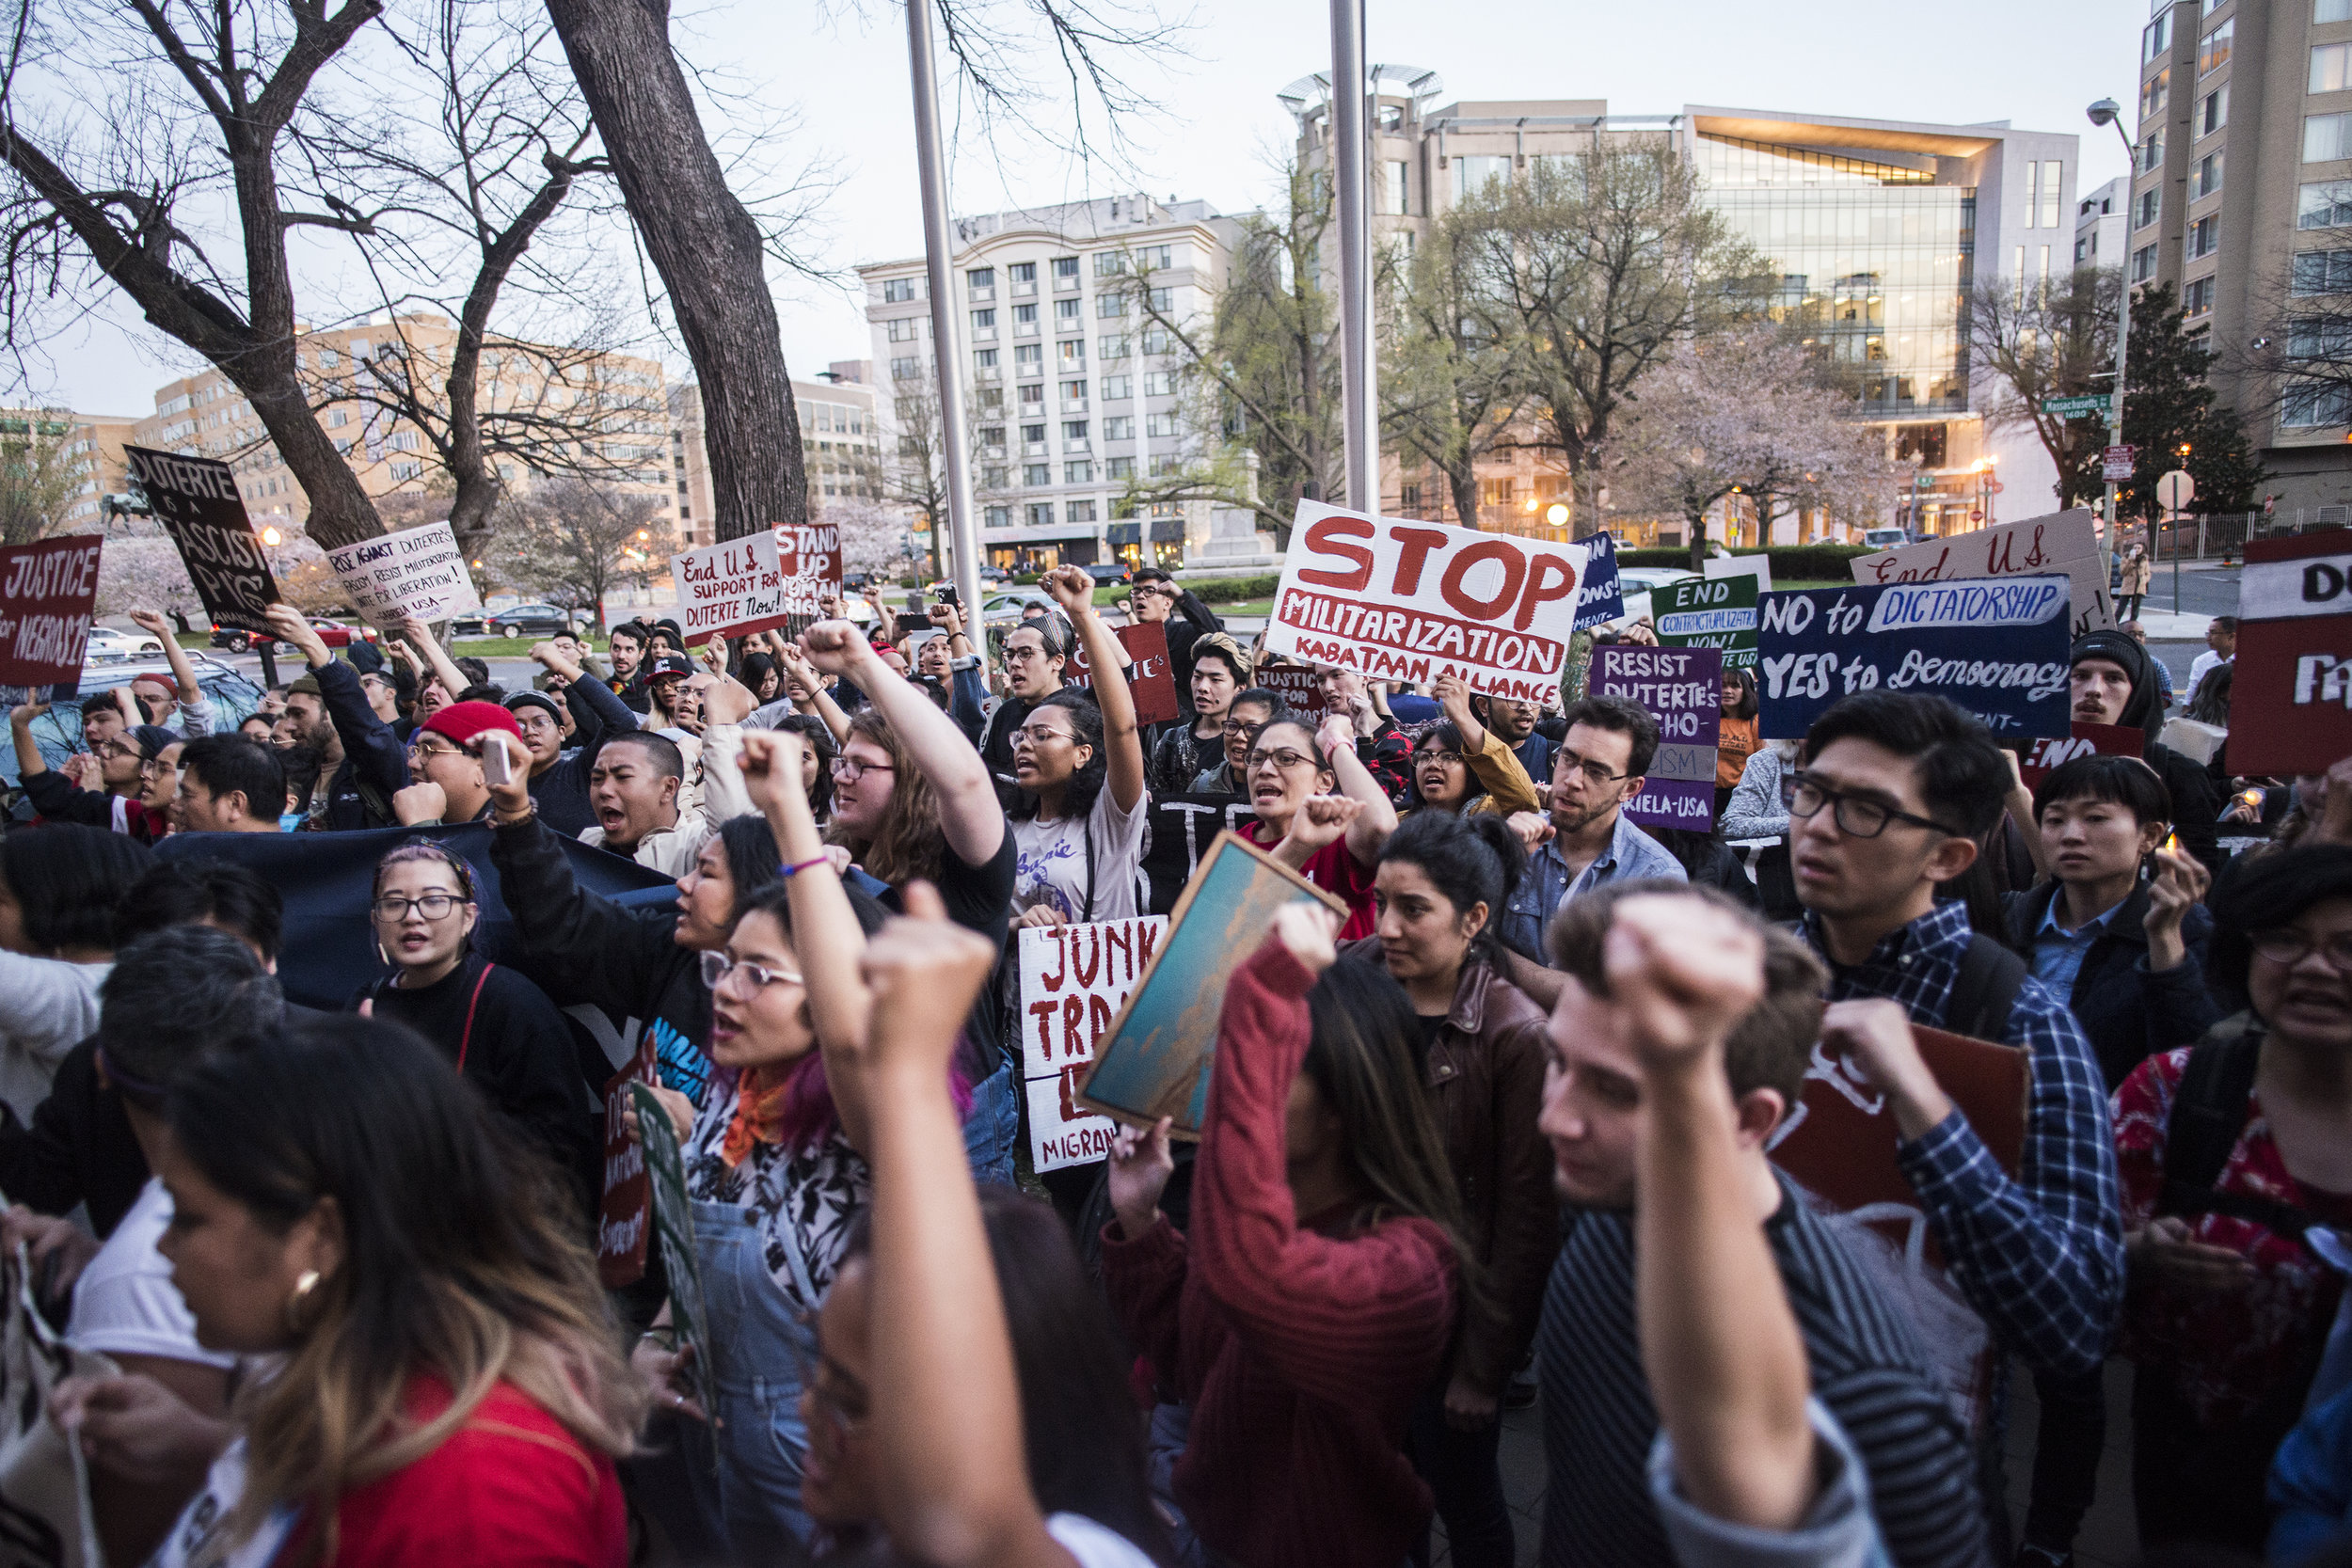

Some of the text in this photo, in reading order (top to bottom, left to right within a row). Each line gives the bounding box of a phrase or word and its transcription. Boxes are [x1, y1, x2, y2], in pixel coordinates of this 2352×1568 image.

[2045, 398, 2098, 411] Massachusetts
[2065, 410, 2087, 419] 1600
[127, 450, 239, 501] DUTERTE
[163, 494, 201, 515] IS A
[157, 513, 266, 572] FASCIST
[773, 525, 840, 555] STAND
[1986, 524, 2051, 575] U.S.
[5, 546, 100, 601] JUSTICE
[329, 551, 357, 575] RISE
[356, 542, 394, 566] AGAINST
[373, 566, 403, 584] RESIST
[680, 544, 763, 583] End U.S.
[796, 553, 830, 577] UP
[1297, 515, 1576, 632] STOP
[192, 562, 269, 619] PIG
[375, 590, 390, 606] FOR
[693, 570, 780, 599] SUPPORT FOR
[1676, 581, 1730, 607] END
[687, 600, 739, 627] DUTERTE
[1761, 584, 2058, 636] NO to DICTATORSHIP
[1284, 592, 1556, 673] MILITARIZATION
[1295, 636, 1430, 684] KABATAAN
[1604, 651, 1692, 679] RESIST
[1761, 649, 2070, 703] YES to Democracy
[1258, 671, 1316, 688] JUSTIC
[1042, 1127, 1118, 1164] MIGRAN
